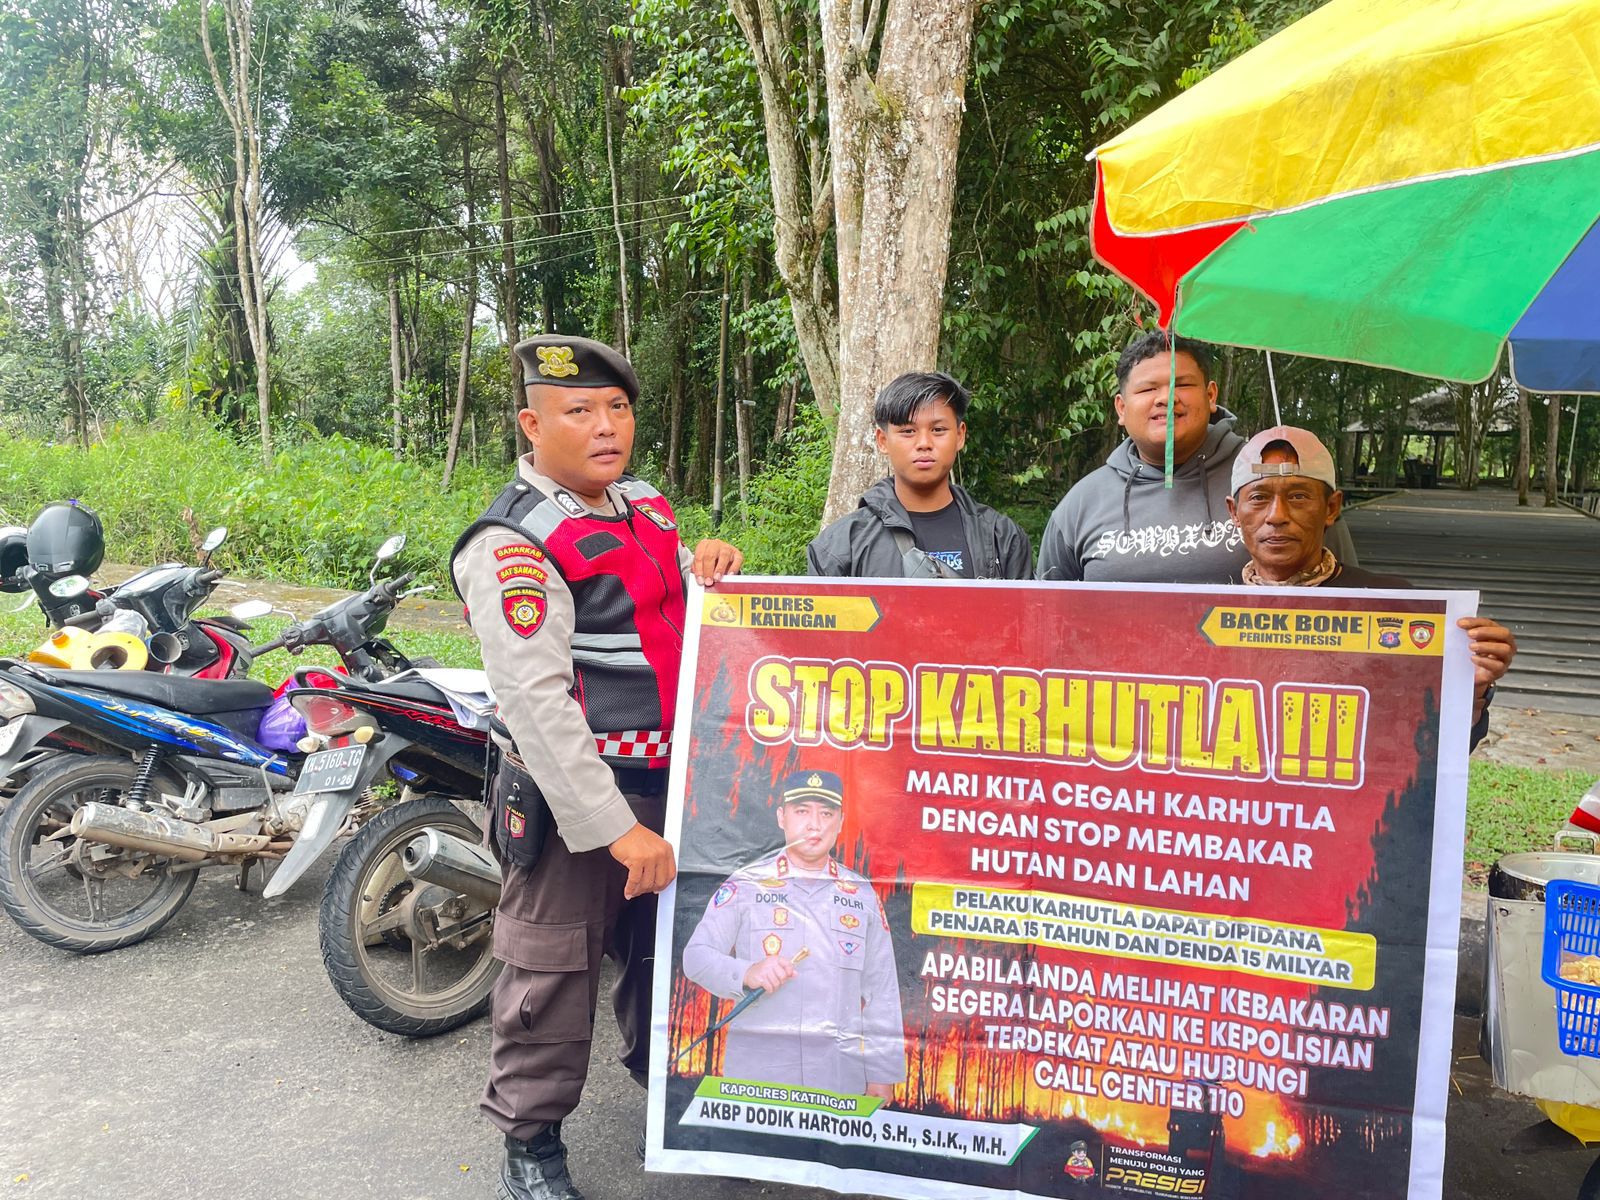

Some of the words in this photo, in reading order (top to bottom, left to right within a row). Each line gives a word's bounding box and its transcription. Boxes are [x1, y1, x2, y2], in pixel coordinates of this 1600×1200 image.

[497, 546, 543, 558] BAHARKAM
[751, 597, 814, 612] POLRES
[751, 613, 836, 629] KATINGAN
[1220, 612, 1290, 632] BACK
[1295, 614, 1363, 635] BONE
[1239, 632, 1292, 645] PERINTIS
[1294, 633, 1342, 647] PRESISI
[751, 659, 907, 745] STOP
[917, 669, 1264, 776] KARHUTLA
[320, 752, 343, 770] 5160
[906, 769, 978, 797] MARI
[985, 775, 1046, 804] KITA
[1051, 782, 1155, 815] CEGAH
[1164, 792, 1336, 832] KARHUTLA
[921, 806, 1038, 838] DENGAN
[1044, 818, 1120, 848] STOP
[1126, 827, 1313, 869] MEMBAKAR
[971, 847, 1065, 879] HUTAN
[1073, 858, 1135, 888] DAN
[1144, 866, 1250, 901] LAHAN
[755, 893, 788, 903] DODIK
[833, 896, 864, 910] POLRI
[955, 891, 1029, 913] PELAKU
[1032, 897, 1138, 927] KARHUTLA
[1142, 912, 1211, 937] DAPAT
[1215, 921, 1323, 952] DIPIDANA
[931, 911, 1020, 936] PENJARA
[1024, 921, 1039, 937] 15
[1042, 923, 1110, 948] TAHUN
[1115, 933, 1160, 955] DAN
[1164, 939, 1238, 964] DENDA
[1241, 949, 1261, 967] 15
[1265, 954, 1350, 981] MILYAR
[920, 951, 1024, 985] APABILA
[1025, 961, 1096, 996] ANDA
[1101, 972, 1216, 1012] MELIHAT
[1220, 987, 1390, 1037] KEBAKARAN
[931, 986, 1025, 1018] SEGERA
[1028, 994, 1166, 1040] LAPORKAN
[1172, 1015, 1205, 1044] KE
[1211, 1022, 1373, 1069] KEPOLISIAN
[984, 1025, 1106, 1058] TERDEKAT
[1108, 1045, 1178, 1073] ATAU
[1184, 1055, 1308, 1096] HUBUNGI
[719, 1083, 788, 1100] KAPOLRES
[790, 1091, 856, 1110] KATINGAN
[1034, 1061, 1097, 1094] CALL
[1102, 1076, 1204, 1110] CENTER
[1209, 1088, 1244, 1117] 110
[700, 1101, 742, 1121] AKBP
[746, 1108, 794, 1128] DODIK
[799, 1113, 877, 1142] HARTONO,
[882, 1124, 916, 1147] S.H.,
[972, 1136, 1007, 1156] M.H.
[1109, 1157, 1148, 1169] MENUJU
[1149, 1162, 1178, 1174] POLRI
[1179, 1168, 1205, 1177] YANG
[1110, 1146, 1182, 1164] TRANSFORMASI
[1105, 1167, 1206, 1194] PRESISI
